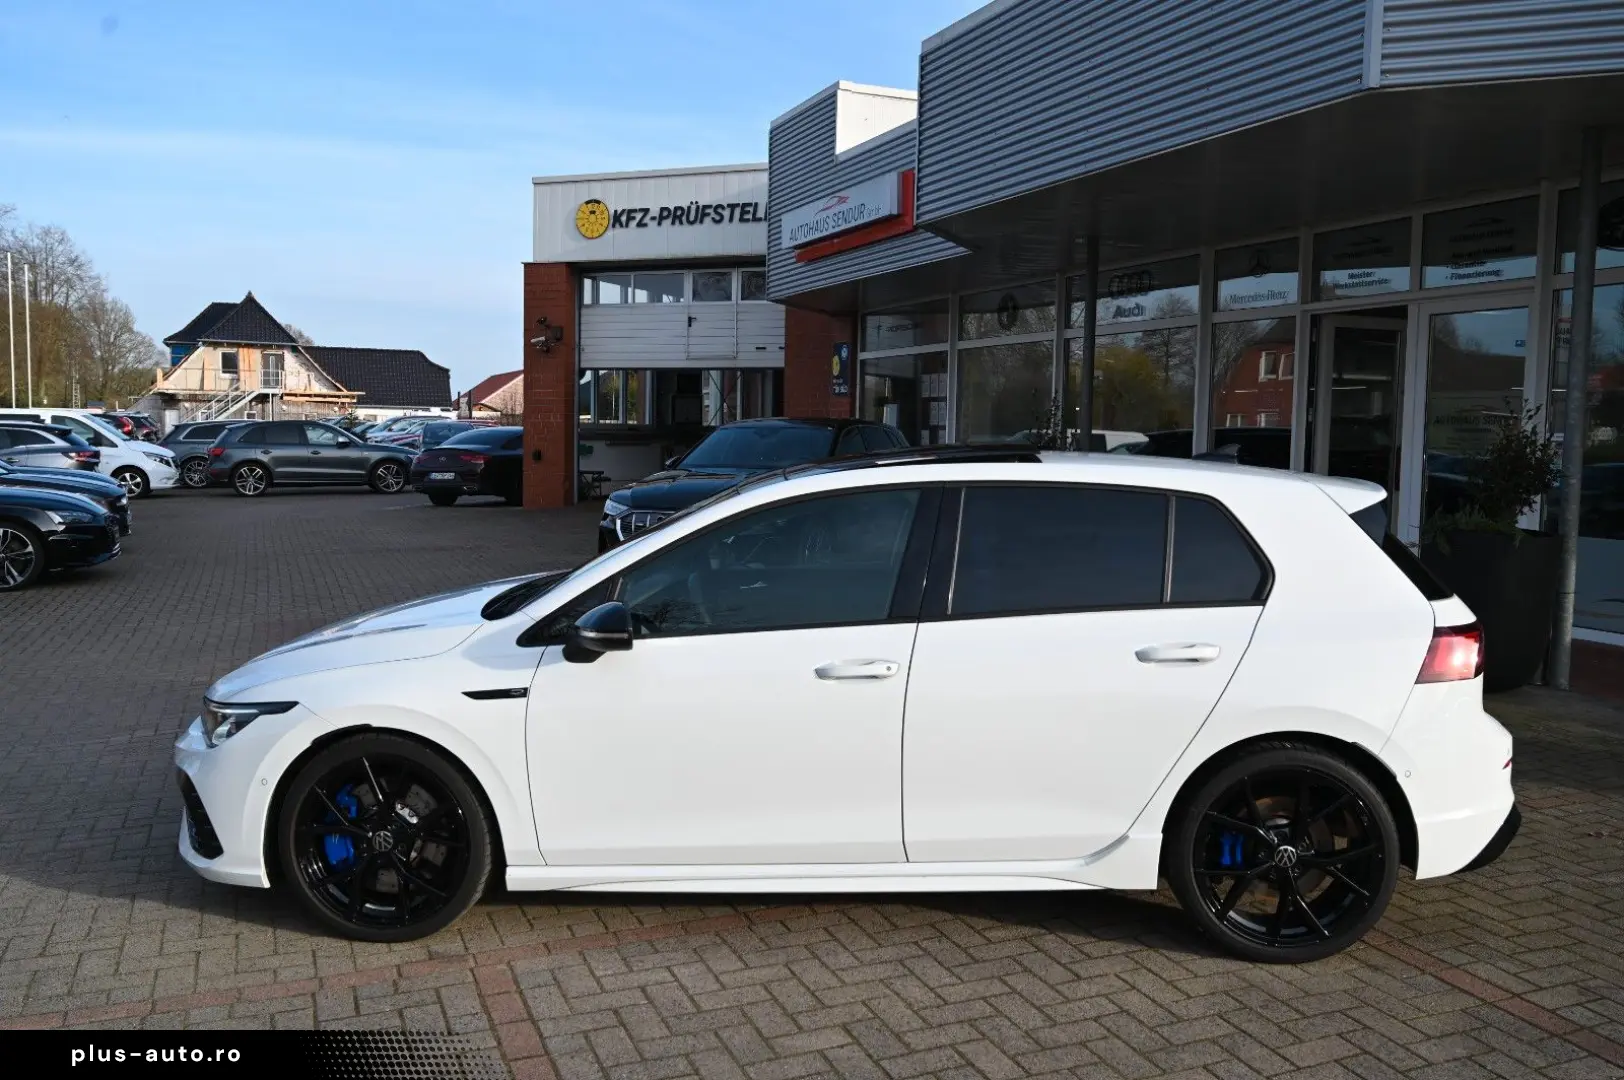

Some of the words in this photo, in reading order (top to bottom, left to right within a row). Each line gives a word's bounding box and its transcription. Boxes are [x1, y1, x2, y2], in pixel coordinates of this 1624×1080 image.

[789, 216, 830, 243] AUTOHAUS
[832, 203, 866, 229] SENDUR
[1113, 302, 1146, 319] Audi
